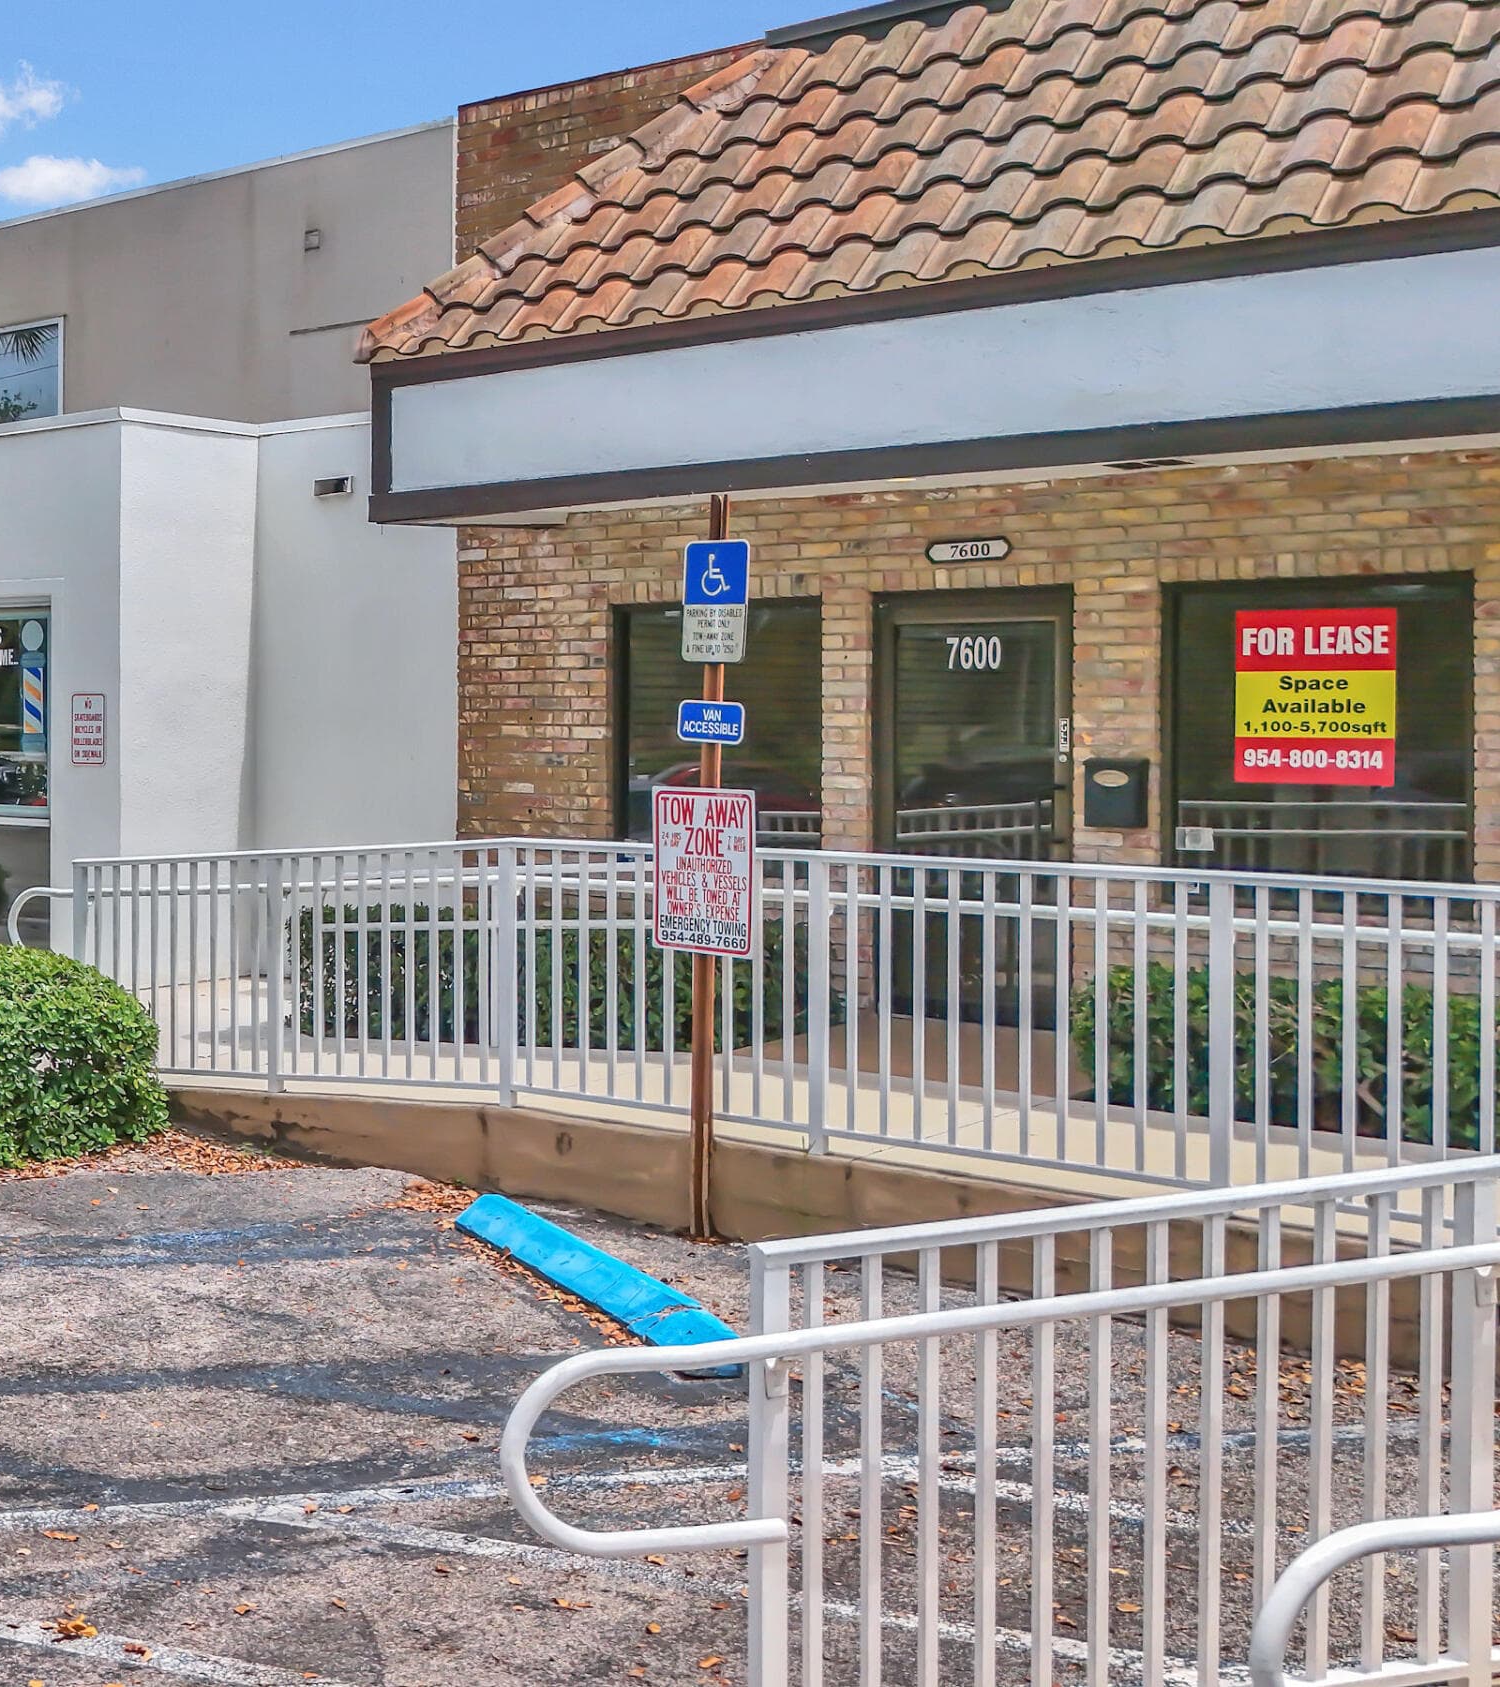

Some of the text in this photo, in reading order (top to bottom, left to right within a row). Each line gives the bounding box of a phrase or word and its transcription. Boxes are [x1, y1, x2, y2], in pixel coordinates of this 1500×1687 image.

[950, 543, 990, 558] 7600
[686, 608, 707, 618] PARKING
[709, 608, 717, 618] BY
[692, 644, 704, 654] FINE
[705, 645, 714, 653] UP
[714, 645, 721, 653] TO
[1242, 625, 1389, 656] FOR LEASE
[946, 636, 1001, 670] 7600
[1279, 675, 1349, 693] Space
[703, 708, 722, 721] VAN
[1262, 699, 1366, 713] Available
[682, 720, 739, 736] ACCESSIBLE
[1244, 720, 1387, 735] 1,100-5,700sqft
[1243, 748, 1383, 769] 954-800-8314
[660, 797, 747, 829] TOW AWAY
[684, 827, 725, 857] ZONE
[676, 856, 732, 874] UNAUTHORIZED
[662, 870, 747, 891] VEHICLES & VESSELS
[666, 885, 741, 907] WILL BE TOWED AT
[667, 900, 740, 921] OWNER'S EXPENSE
[659, 914, 747, 937] EMERGENCY TOWING
[661, 930, 746, 950] 954-489-7660
